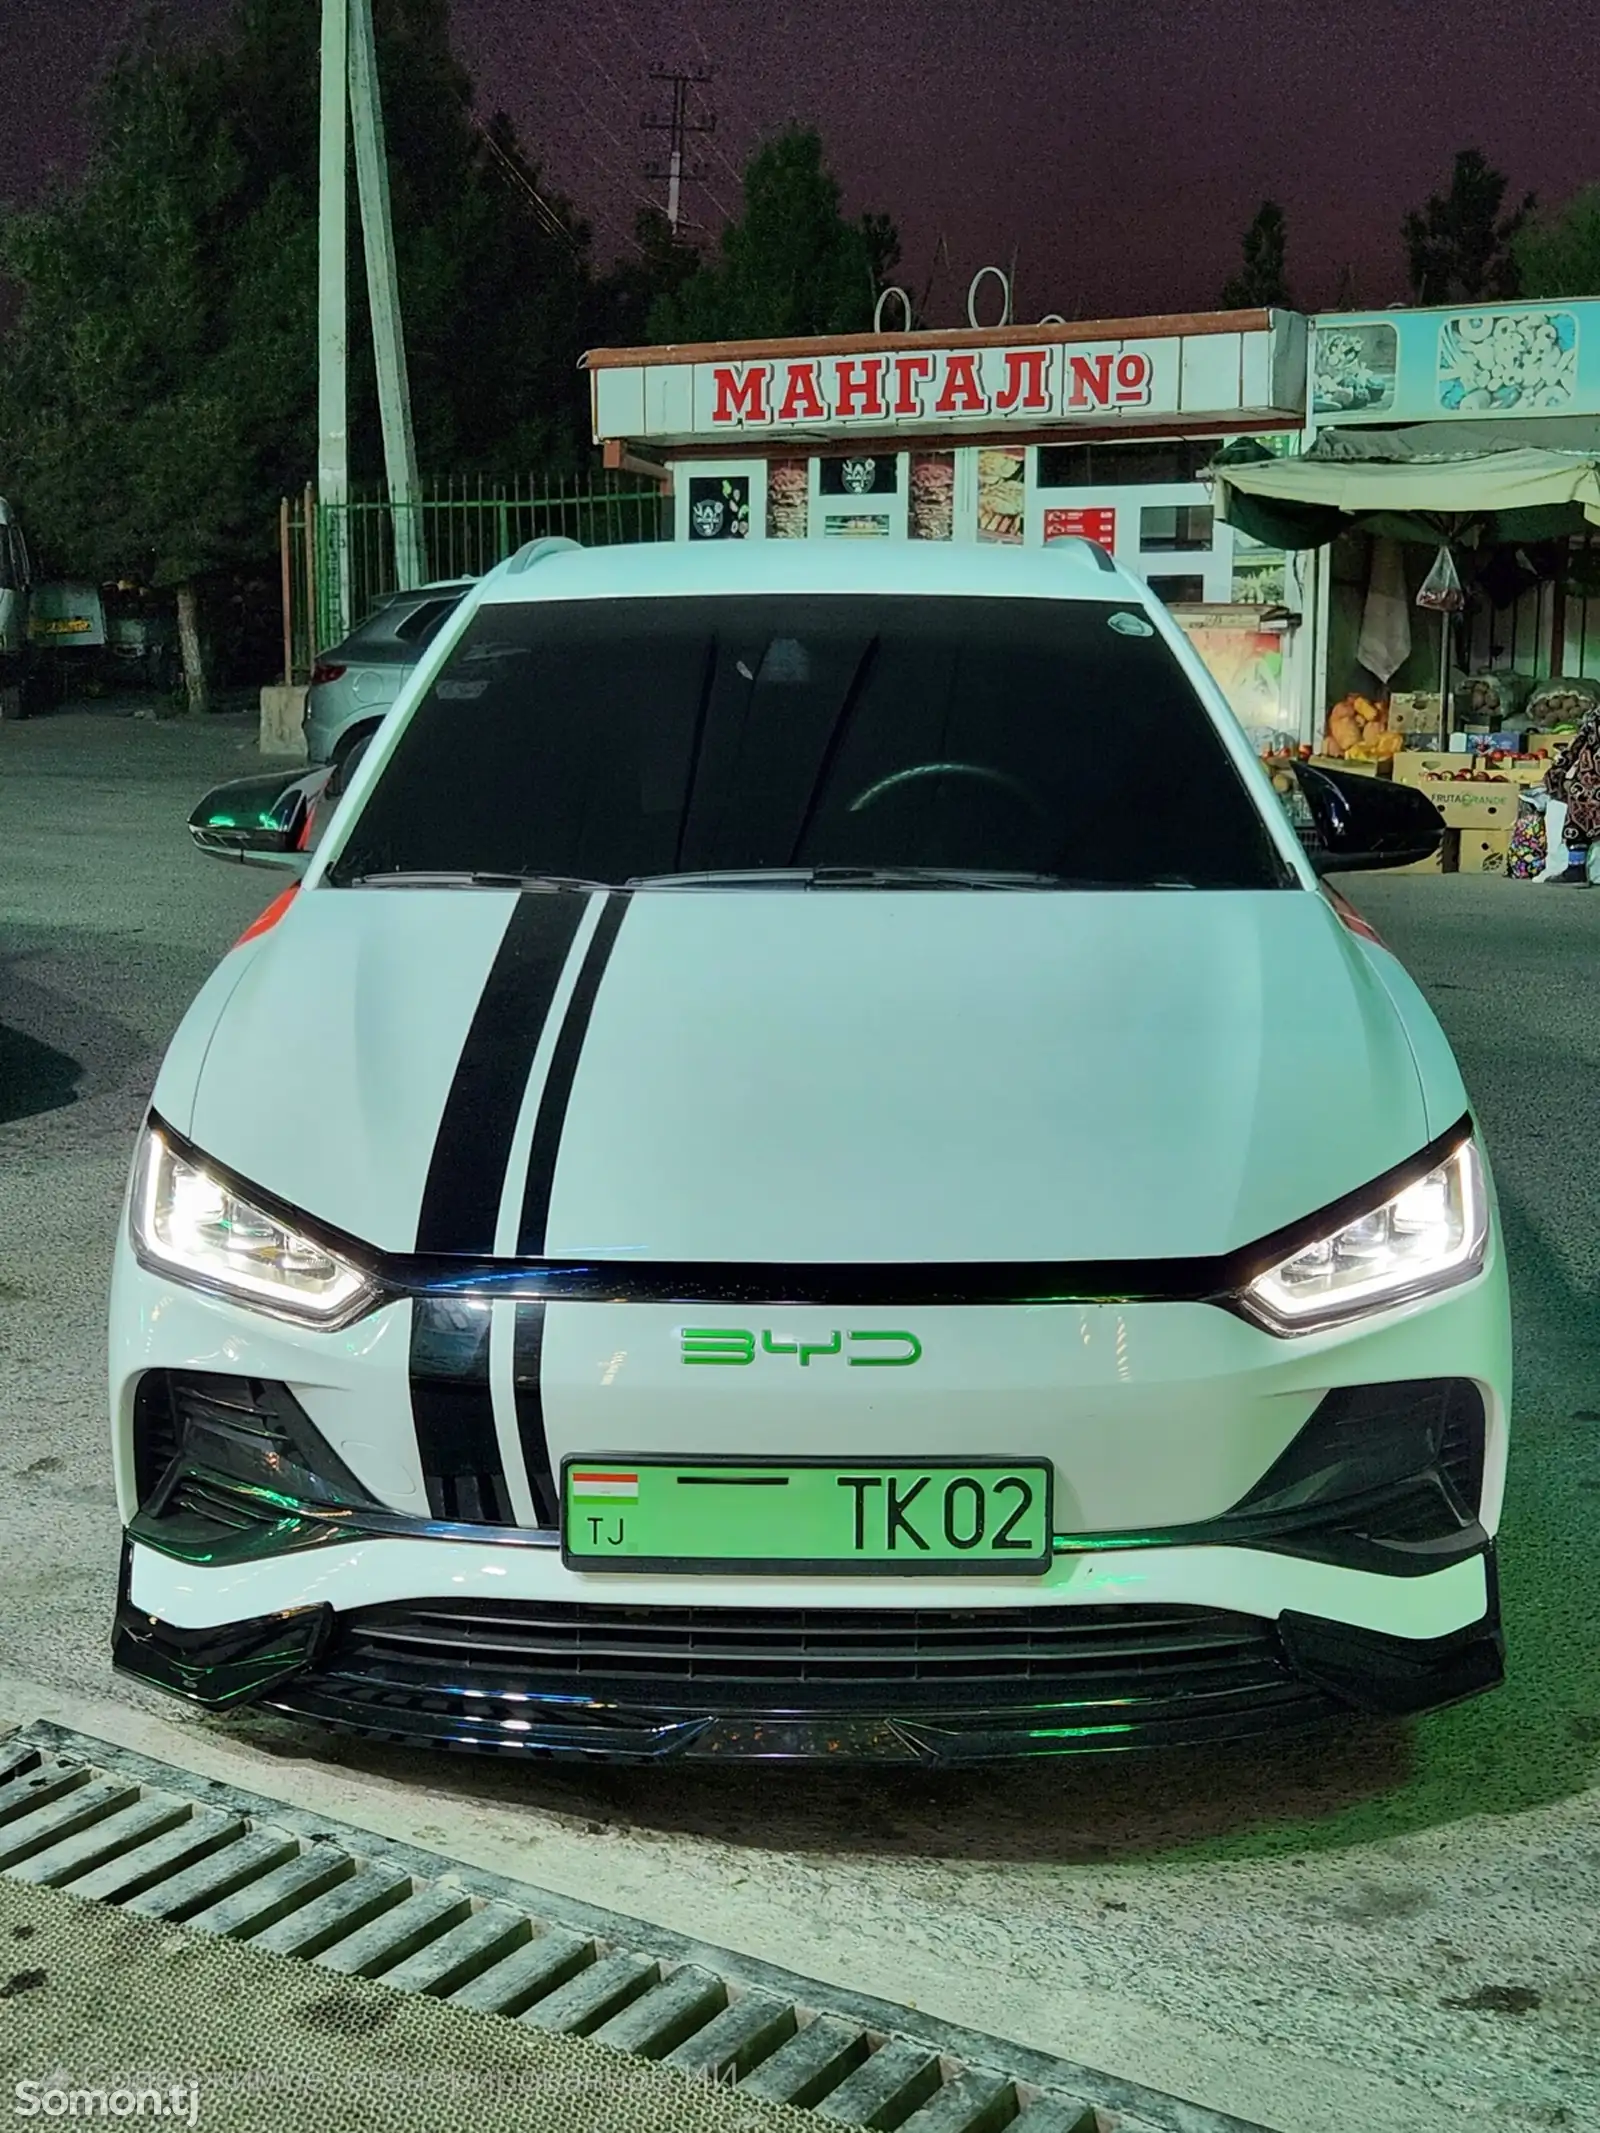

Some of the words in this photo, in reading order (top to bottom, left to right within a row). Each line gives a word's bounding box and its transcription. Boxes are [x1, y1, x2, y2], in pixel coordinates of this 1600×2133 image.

[712, 351, 1048, 422] МАНГАЛ
[680, 1328, 923, 1367] BYD
[586, 1516, 625, 1546] TJ
